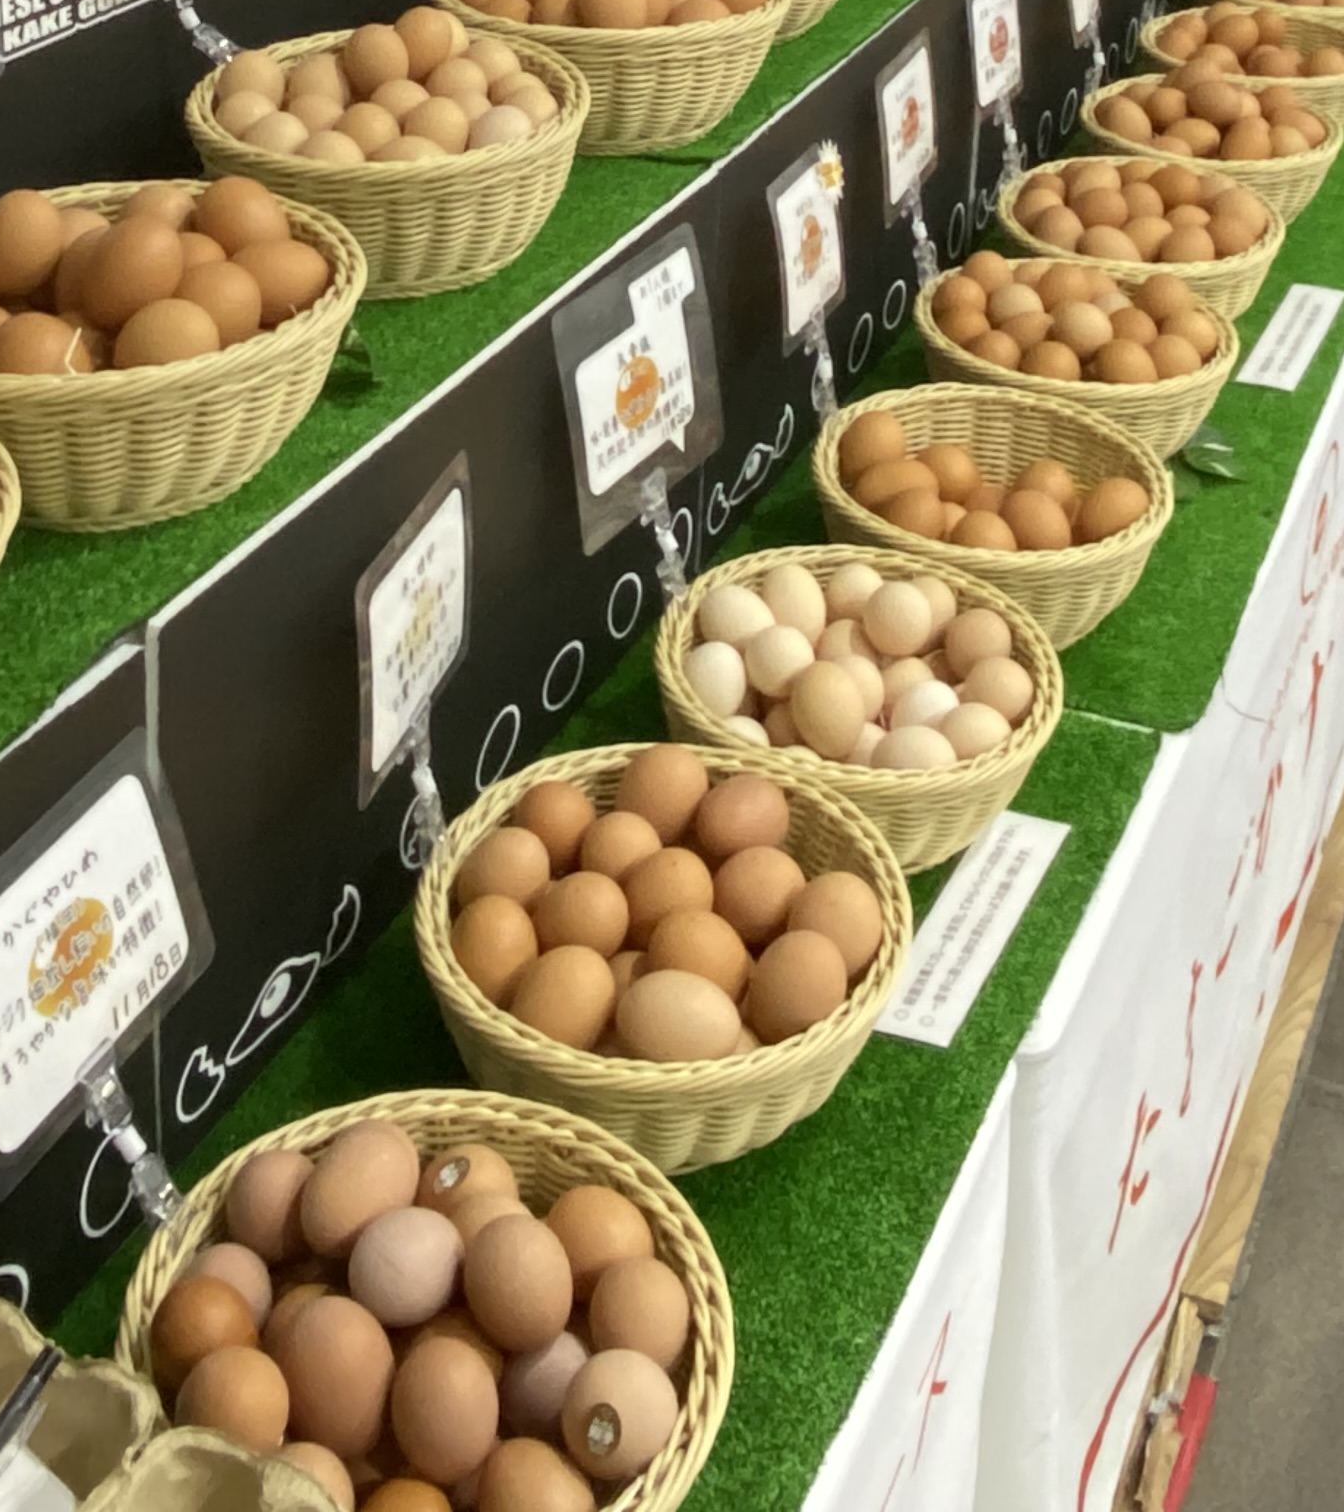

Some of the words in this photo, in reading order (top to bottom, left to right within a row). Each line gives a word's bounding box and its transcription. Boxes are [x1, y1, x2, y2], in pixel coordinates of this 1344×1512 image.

[3, 5, 74, 53] KAKE
[1, 849, 99, 949] かぐやひめ
[112, 941, 183, 1033] 11月18日
